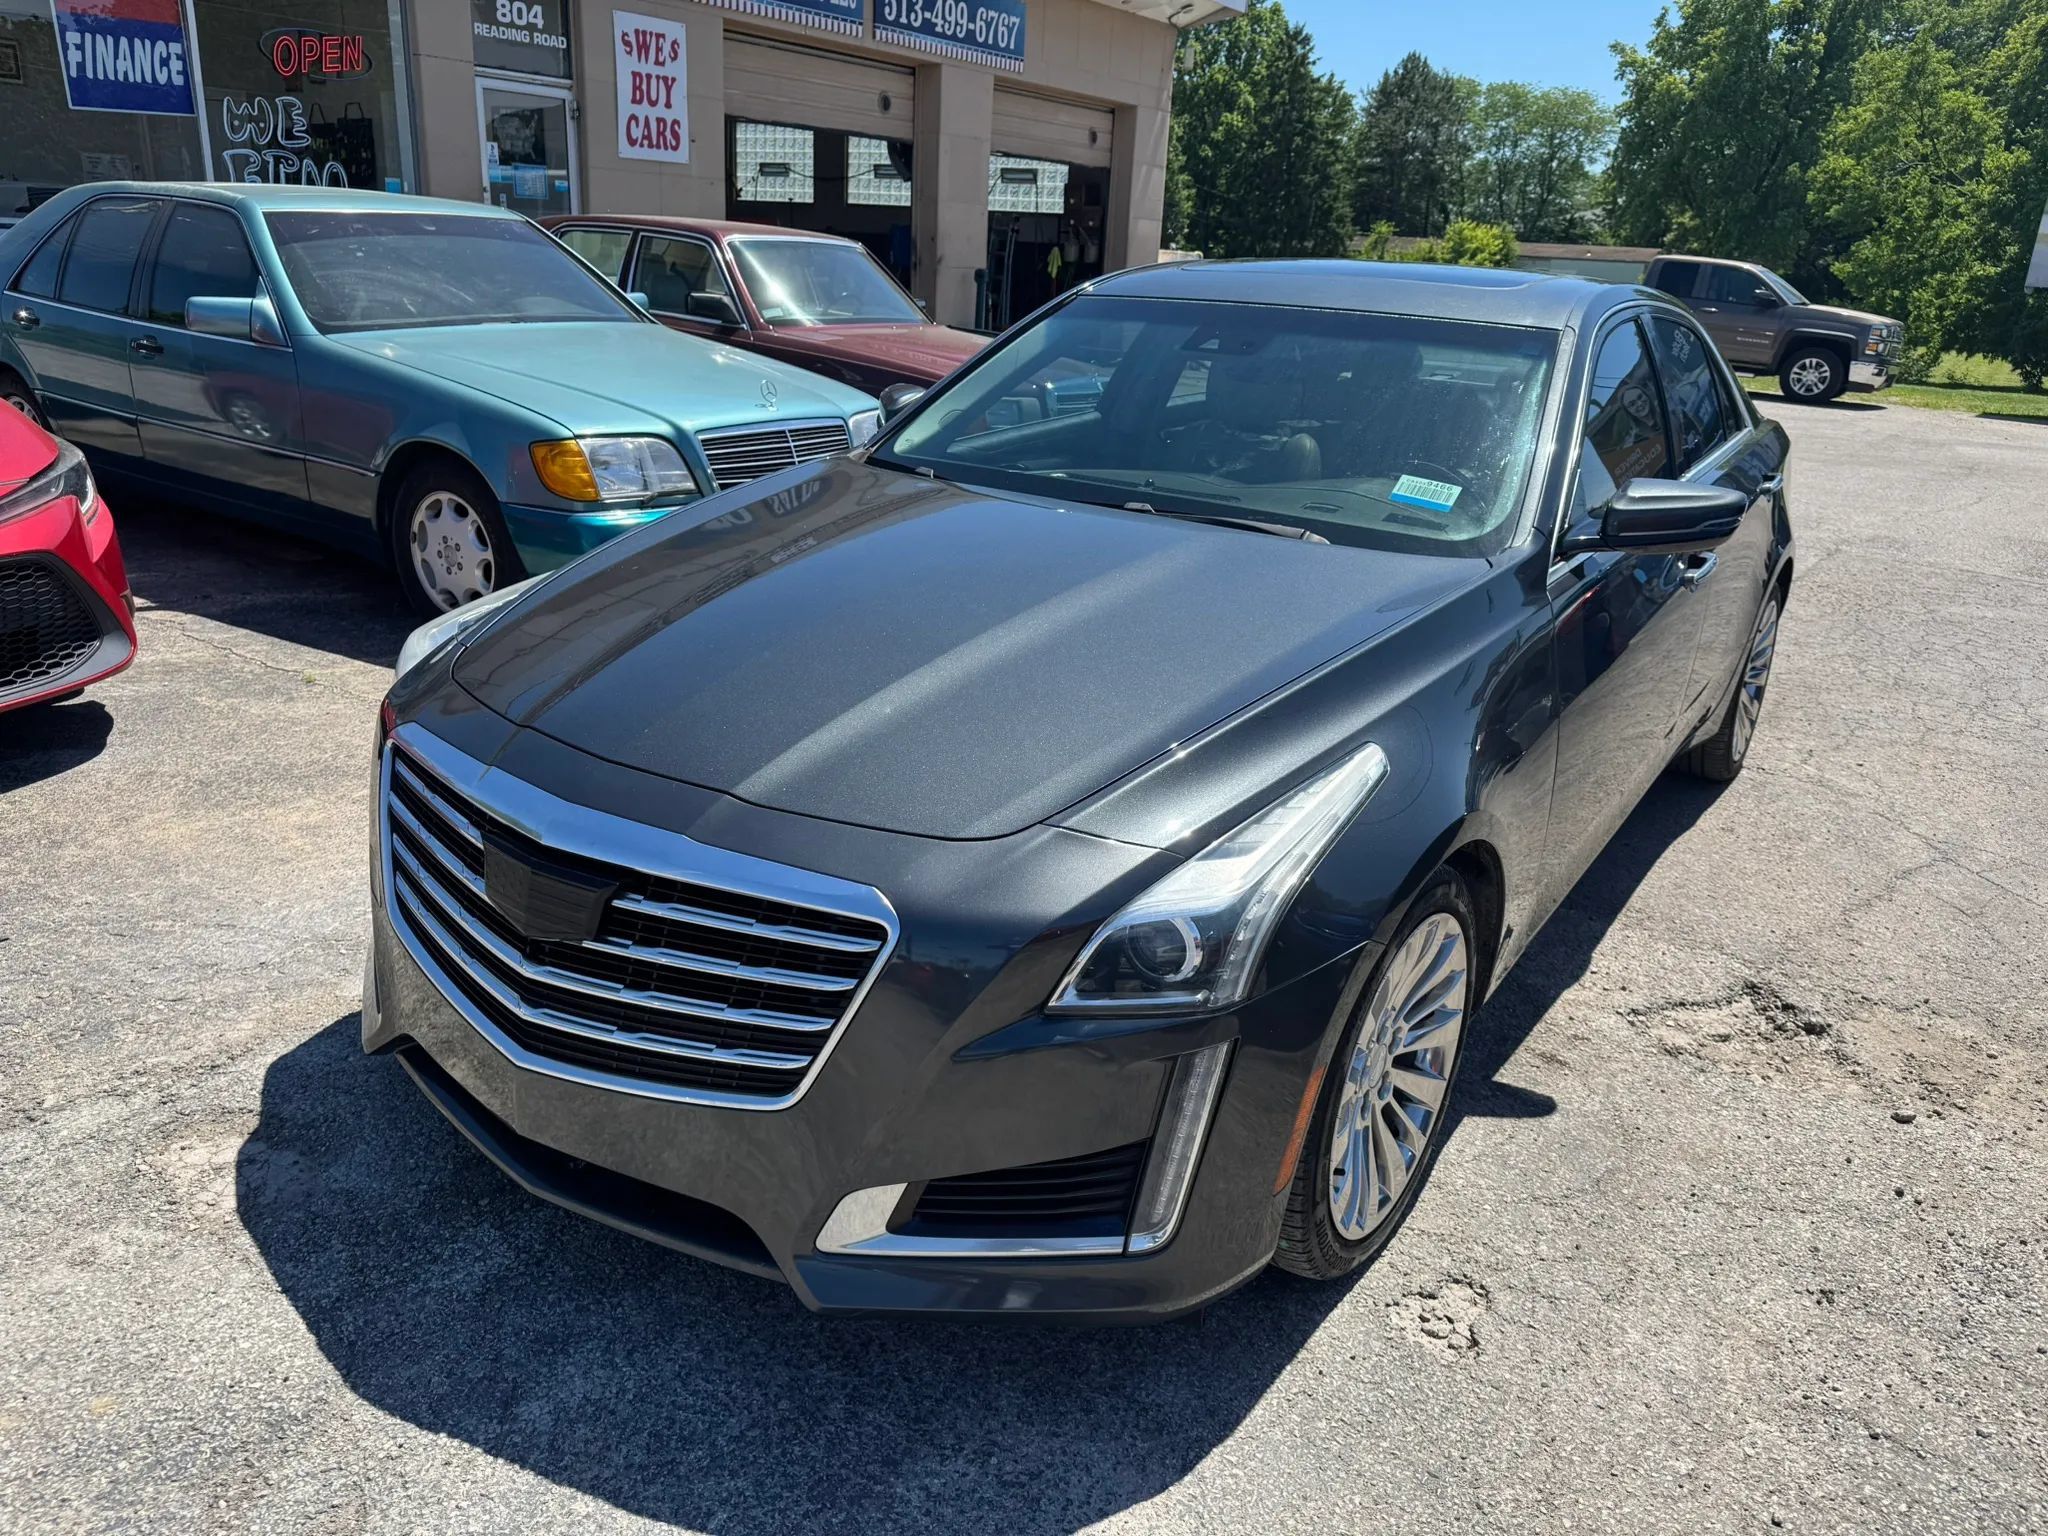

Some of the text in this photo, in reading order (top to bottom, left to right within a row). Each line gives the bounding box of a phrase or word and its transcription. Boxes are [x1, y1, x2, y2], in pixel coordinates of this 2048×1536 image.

[496, 0, 544, 29] 804
[474, 22, 567, 49] READING ROAD
[65, 31, 185, 86] FINANCE
[273, 35, 363, 76] OPEN
[631, 71, 676, 109] BUY
[223, 96, 311, 147] WE
[626, 113, 681, 152] CARS
